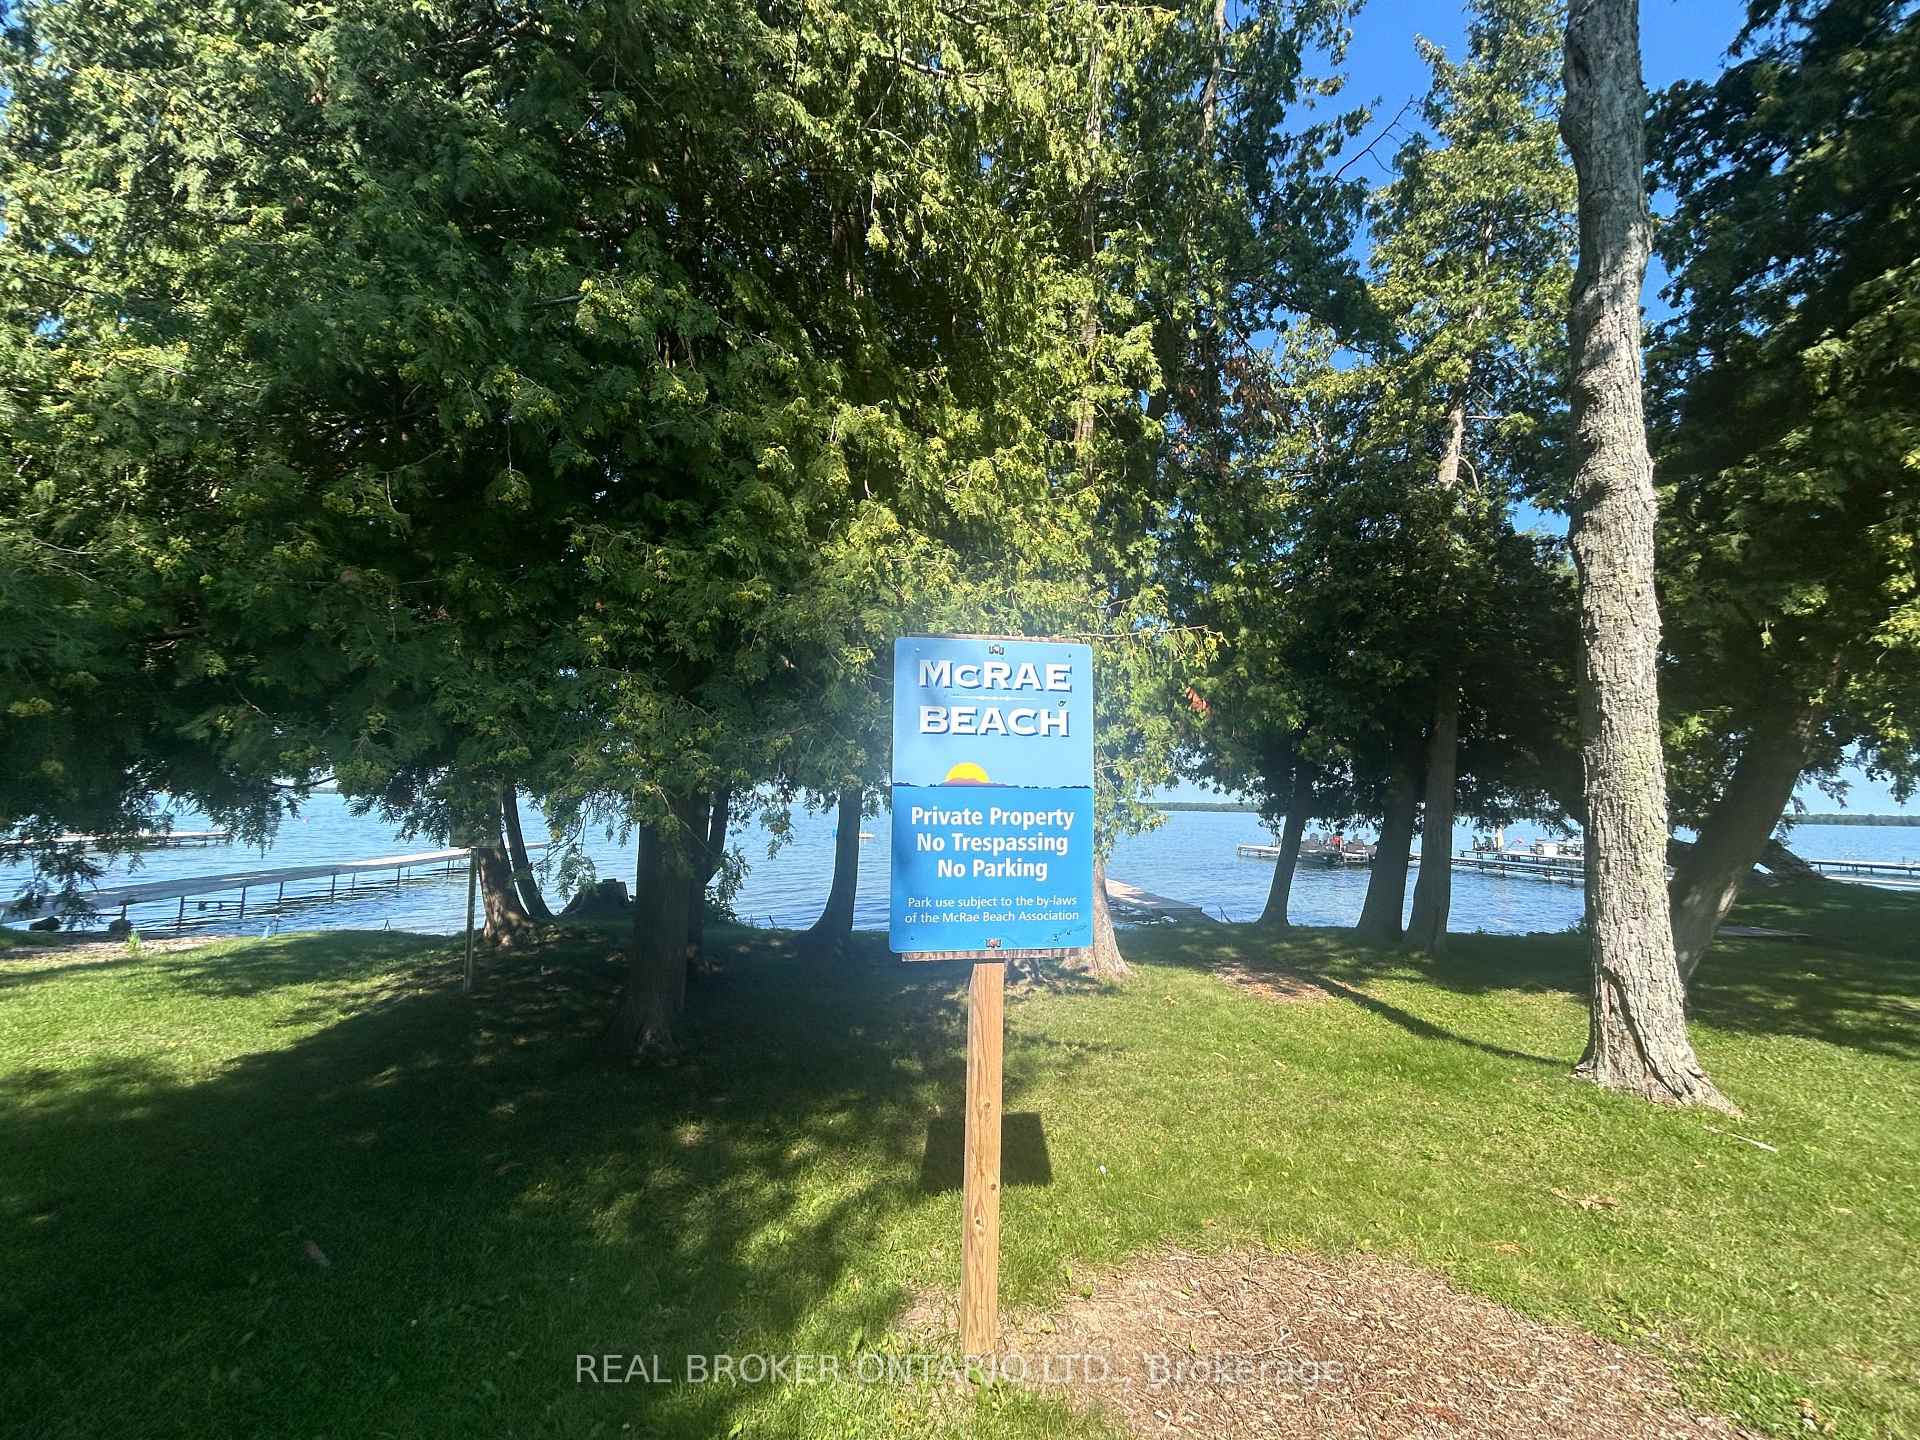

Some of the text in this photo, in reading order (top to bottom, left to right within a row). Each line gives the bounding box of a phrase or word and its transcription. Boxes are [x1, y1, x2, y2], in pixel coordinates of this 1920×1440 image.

[920, 659, 1072, 693] McRAE
[920, 705, 1069, 737] BEACH
[911, 806, 1075, 830] Private Property
[917, 832, 1068, 856] No Trespassing
[937, 858, 1048, 881] No Parking
[908, 895, 1078, 909] Park use subject to the by-laws
[904, 910, 1079, 923] of the McRae Beach Association
